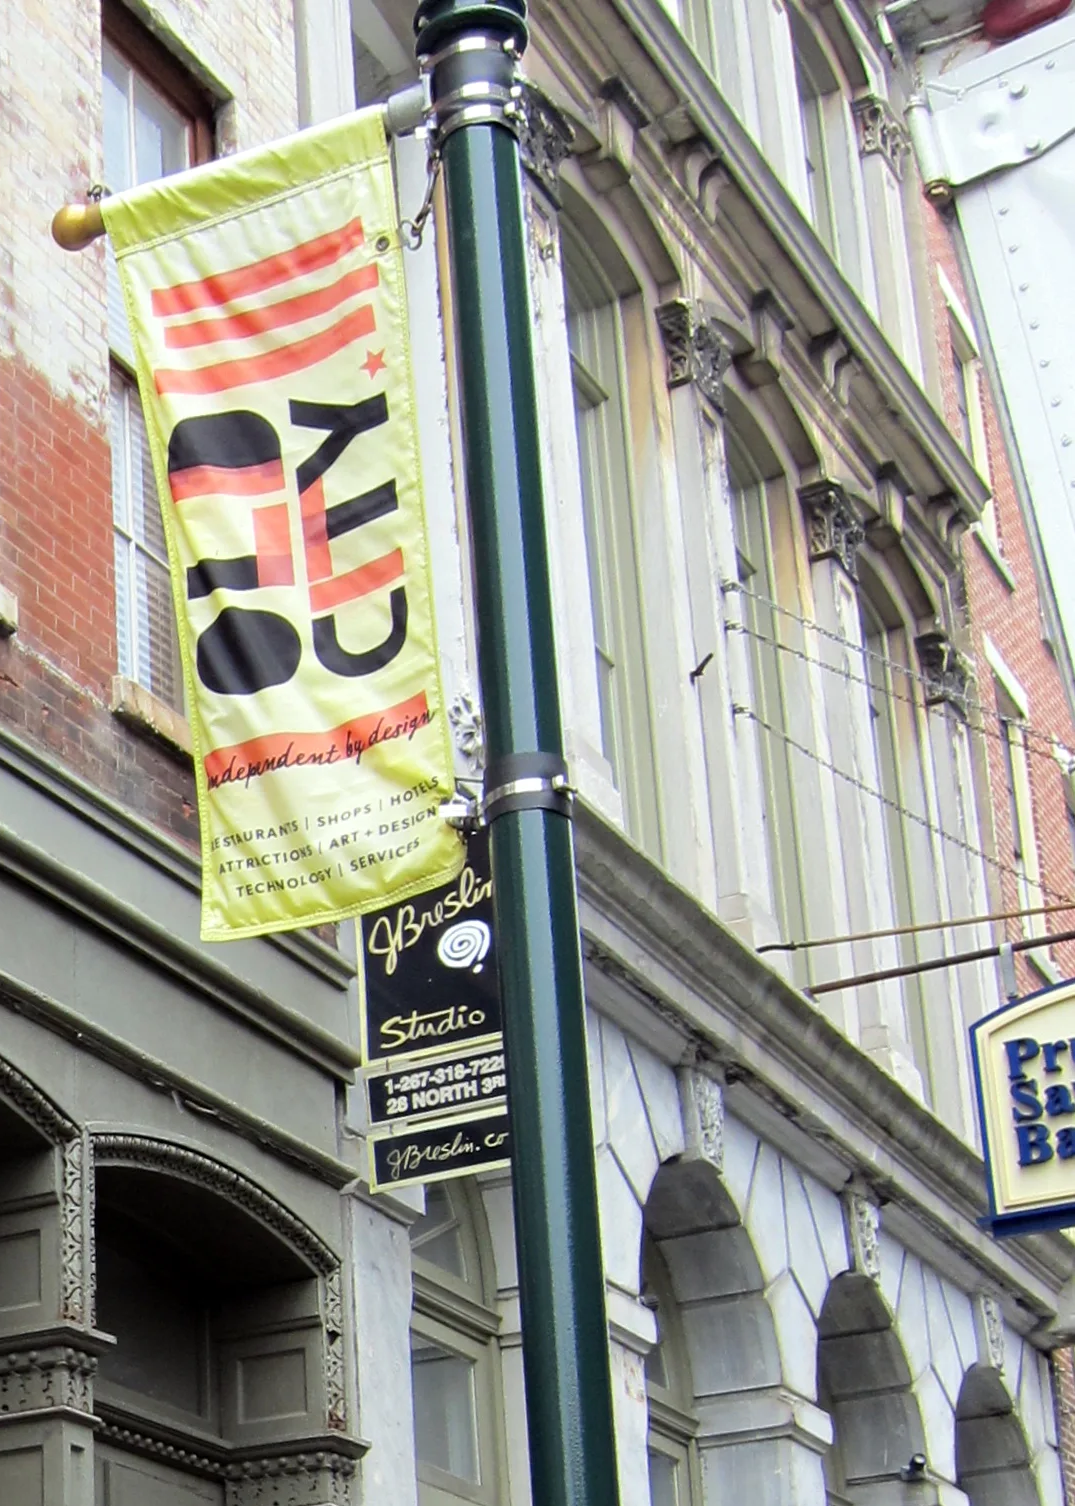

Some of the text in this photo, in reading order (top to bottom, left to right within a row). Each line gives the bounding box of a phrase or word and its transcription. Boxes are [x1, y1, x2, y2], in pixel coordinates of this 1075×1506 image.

[168, 409, 302, 696] OLD
[288, 390, 408, 678] CITY
[346, 730, 367, 765] by
[368, 709, 436, 748] design
[316, 803, 372, 828] SHOPS
[390, 776, 440, 807] HOTELS
[329, 831, 360, 851] ART
[378, 805, 438, 837] DESIGN
[236, 837, 421, 898] TECHNOLOGY SERVICES
[380, 1005, 485, 1050] Studio
[1003, 1037, 1075, 1081] Pr
[412, 1079, 478, 1110] NORTH
[1010, 1078, 1075, 1122] Sa
